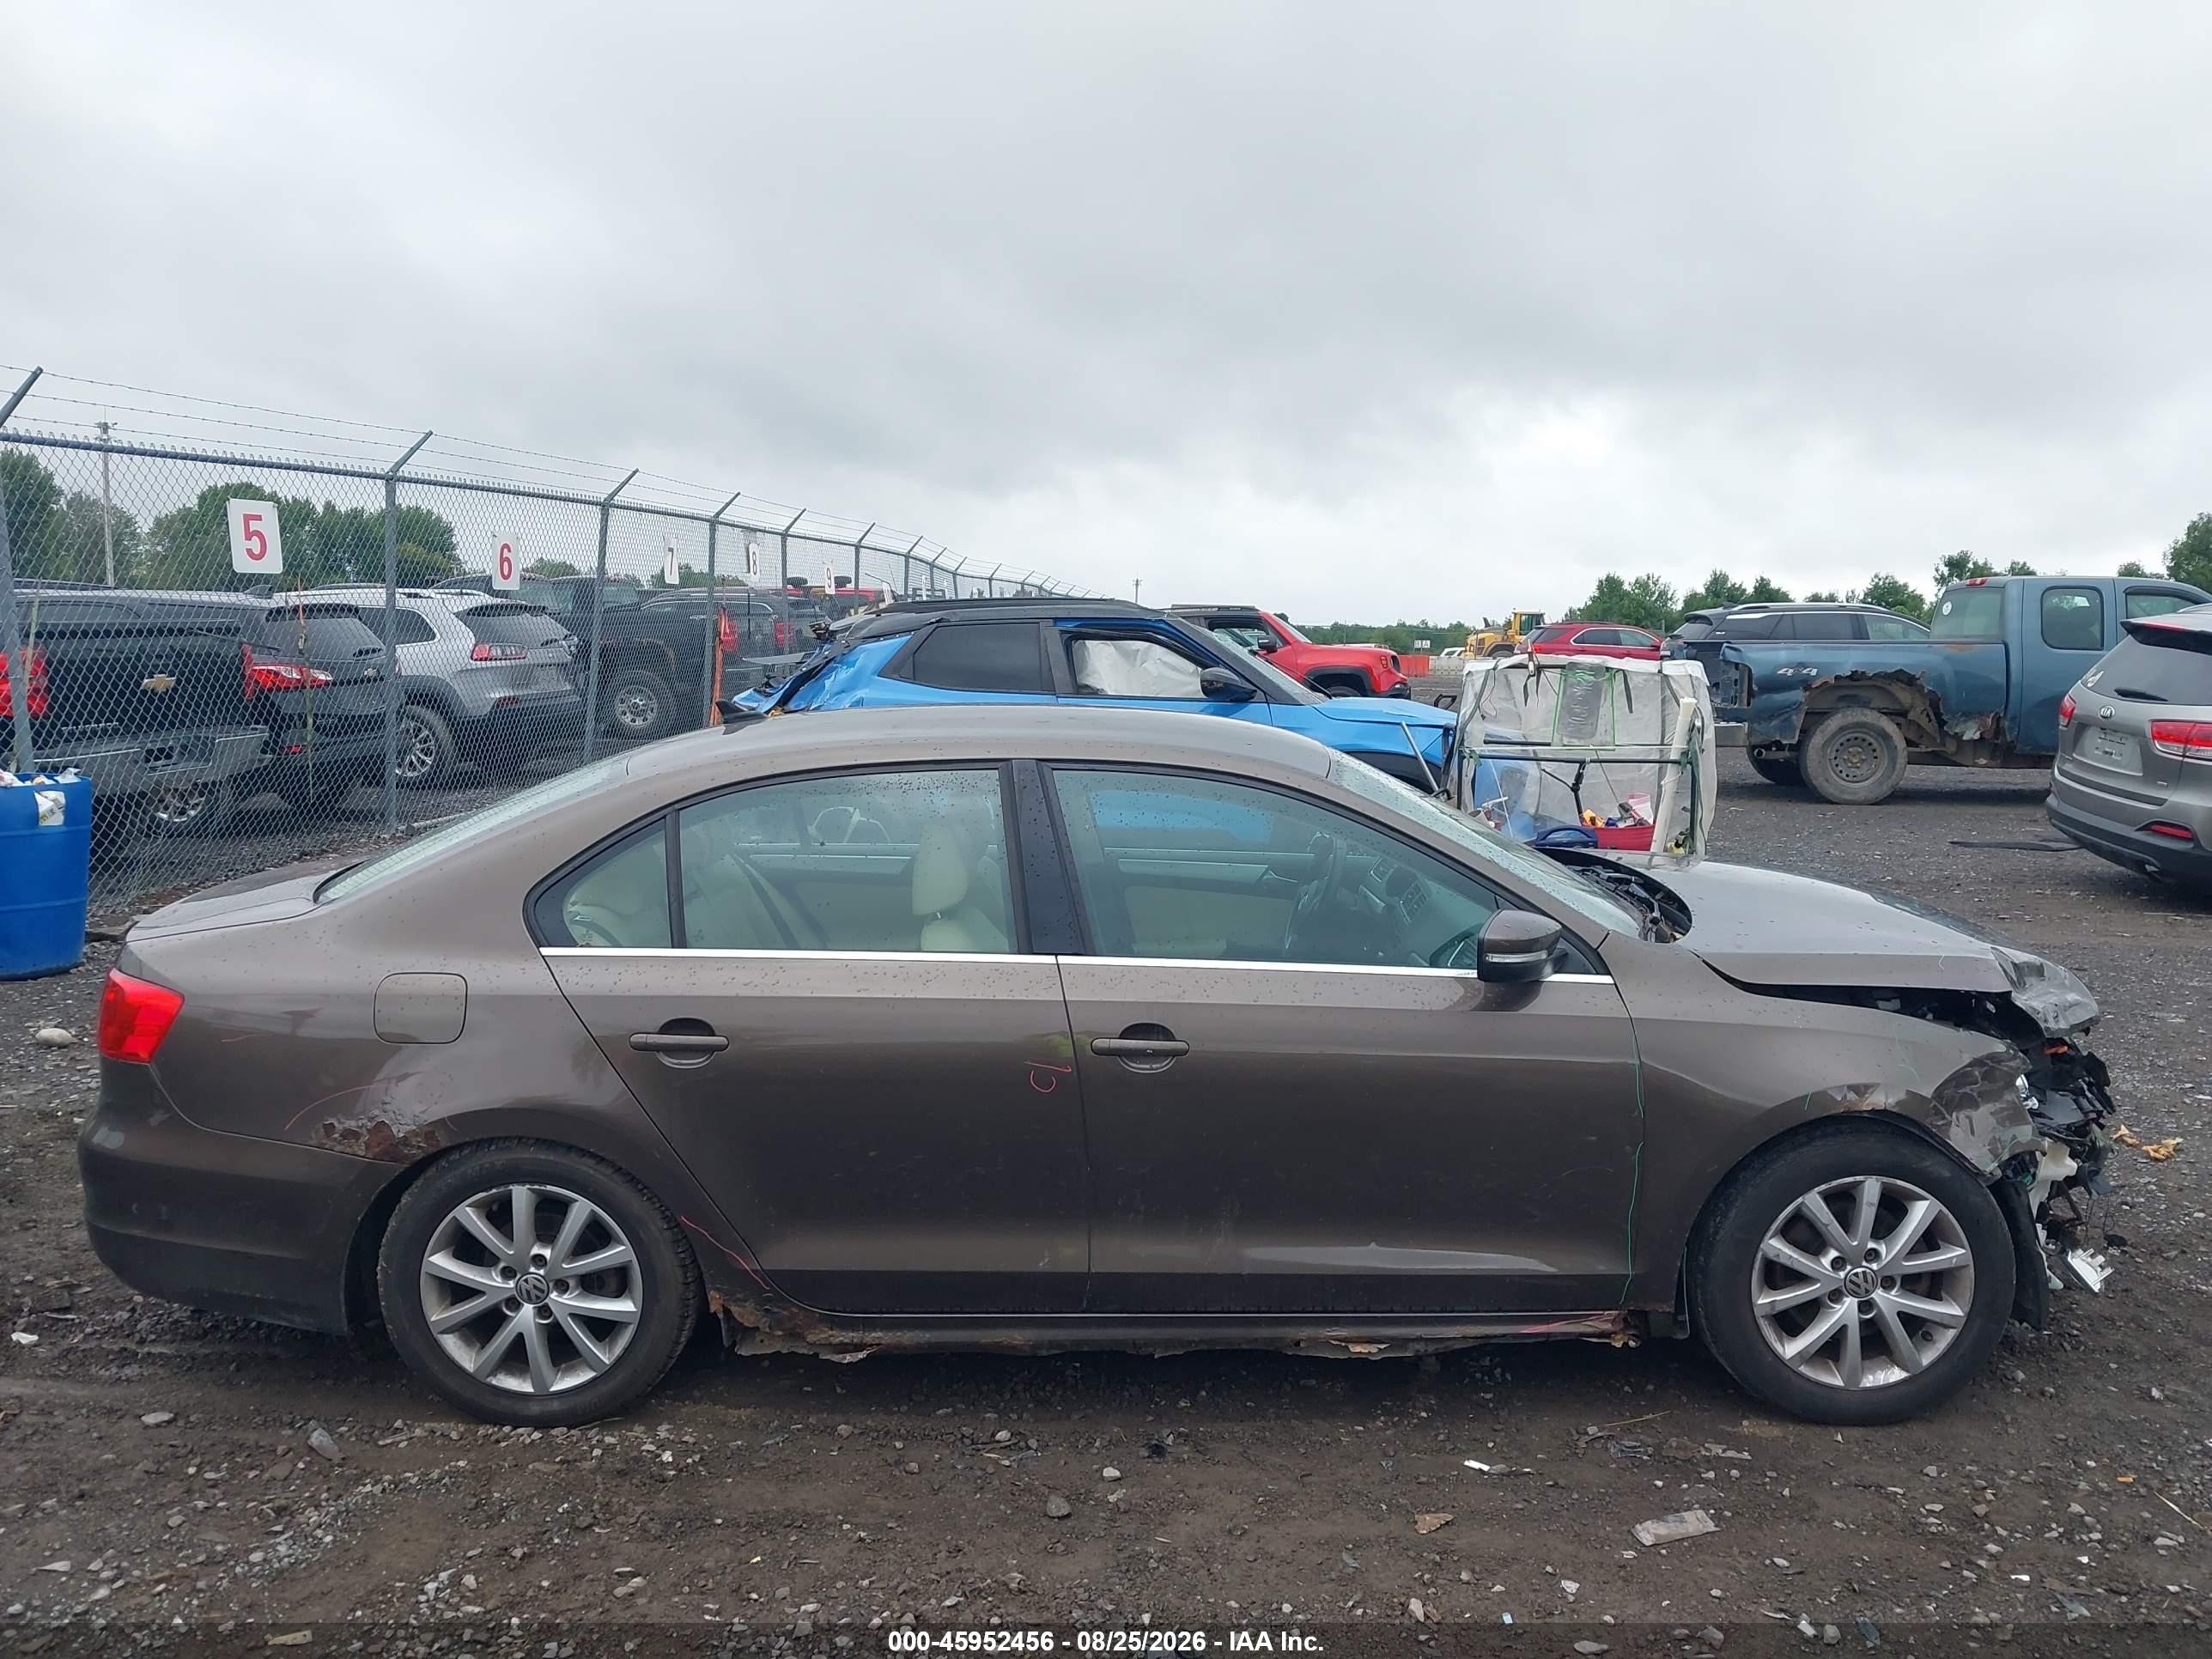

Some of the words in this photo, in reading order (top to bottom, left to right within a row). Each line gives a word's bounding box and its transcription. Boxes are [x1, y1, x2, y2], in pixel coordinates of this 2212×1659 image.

[242, 513, 267, 562] 5
[499, 543, 513, 580] 6
[668, 547, 674, 576] 7
[751, 550, 757, 575] 8
[826, 567, 832, 589] 9
